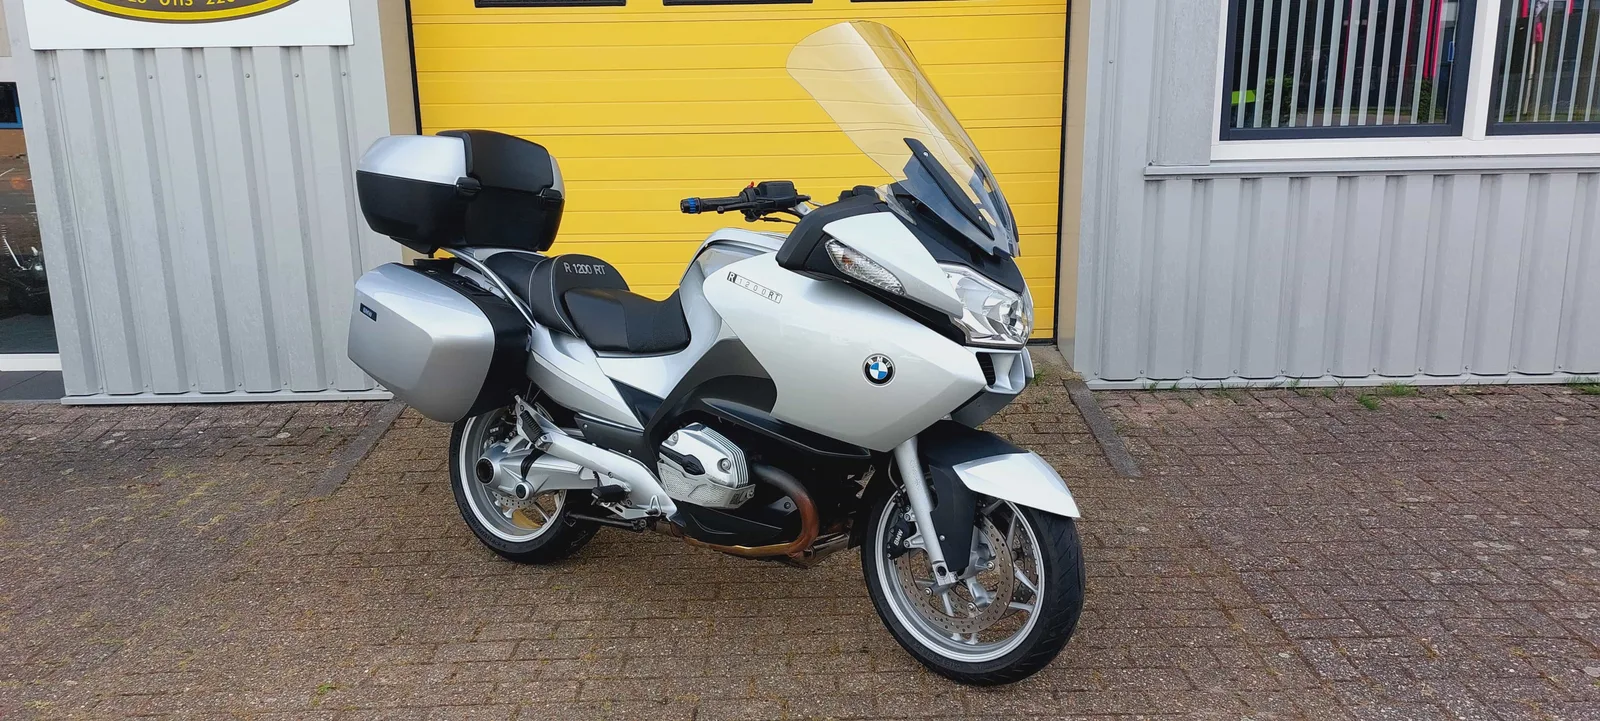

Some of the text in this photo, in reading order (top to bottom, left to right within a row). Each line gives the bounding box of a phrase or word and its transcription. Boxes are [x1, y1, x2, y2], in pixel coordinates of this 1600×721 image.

[563, 262, 606, 275] R 1200 RT
[728, 272, 736, 283] R
[867, 355, 892, 368] BMW
[893, 528, 904, 546] BMW
